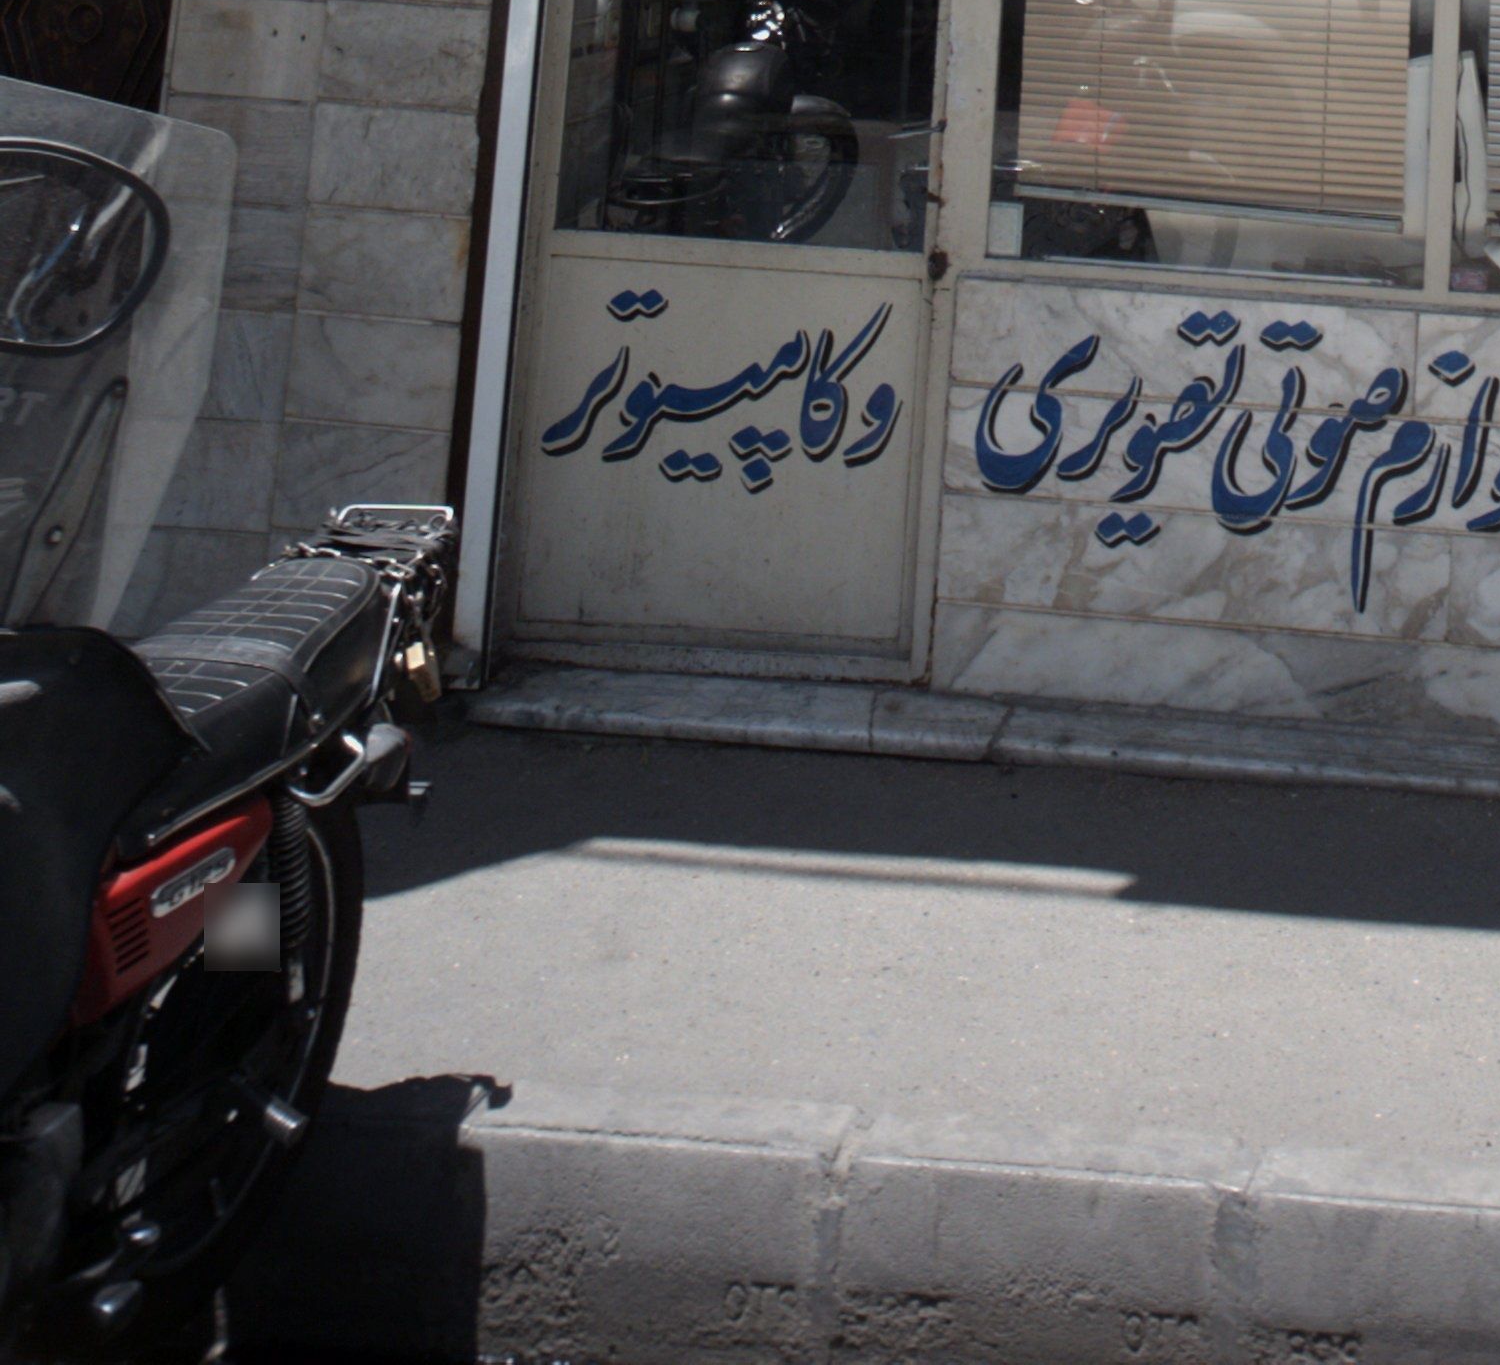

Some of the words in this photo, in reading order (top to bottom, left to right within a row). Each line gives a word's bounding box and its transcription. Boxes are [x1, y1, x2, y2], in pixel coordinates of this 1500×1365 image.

[541, 288, 893, 492] کامپیوتر
[843, 382, 904, 467] و
[975, 309, 1249, 550] تصویری
[1211, 319, 1409, 535] صوتی
